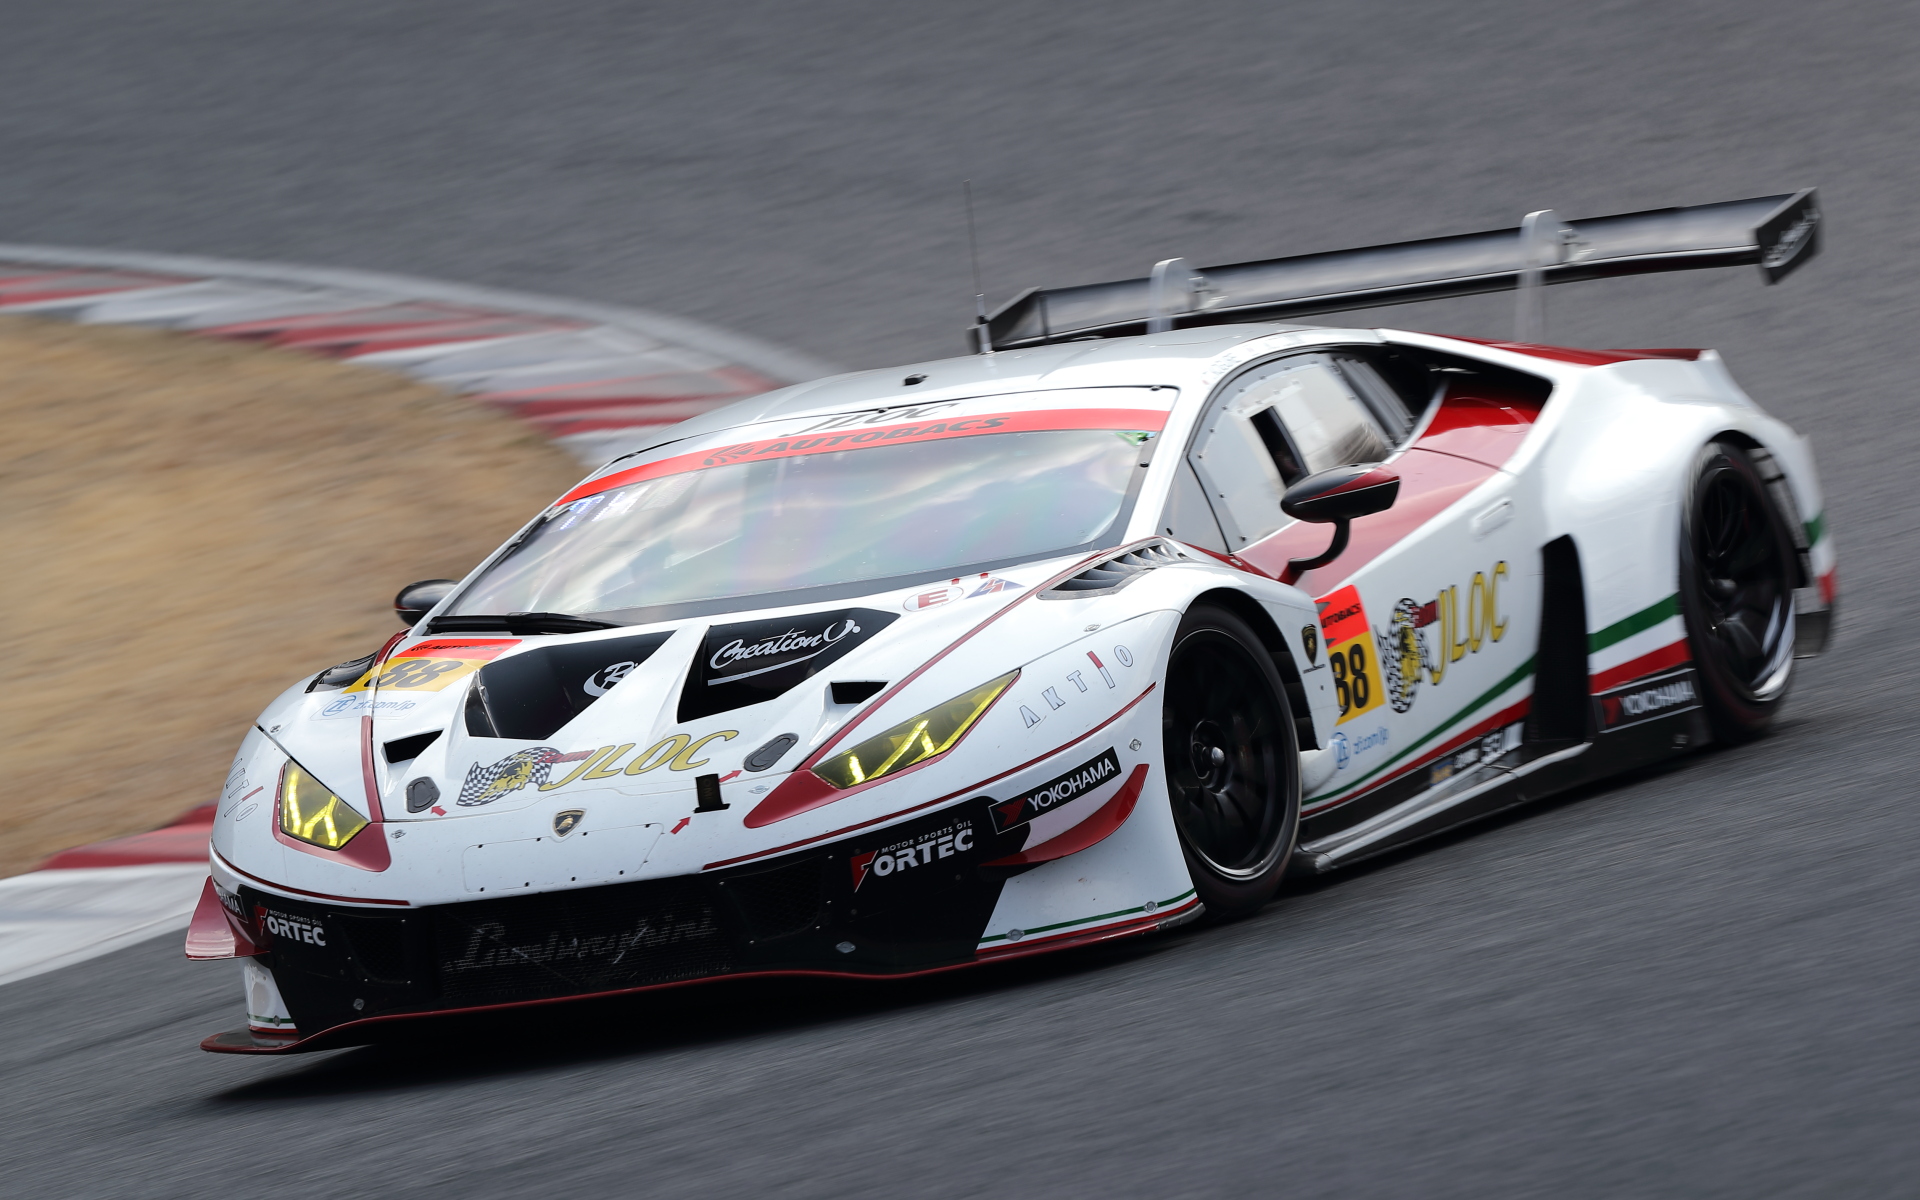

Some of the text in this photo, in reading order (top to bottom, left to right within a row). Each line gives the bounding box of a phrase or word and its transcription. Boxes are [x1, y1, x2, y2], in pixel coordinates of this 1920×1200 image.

[756, 416, 1011, 456] AUTOBACS
[779, 402, 960, 437] JLOC
[1430, 560, 1509, 687] JLOC
[427, 643, 504, 652] AUTOBACS
[709, 627, 823, 670] Creation
[364, 659, 464, 689] 88
[1019, 644, 1134, 729] AKTIO
[353, 699, 416, 711] zf.com/jp
[537, 730, 739, 791] Team JLOC
[1027, 757, 1115, 812] YOKOHAMA
[881, 819, 973, 854] MOTOR SPORTS OIL
[312, 918, 323, 927] OIL
